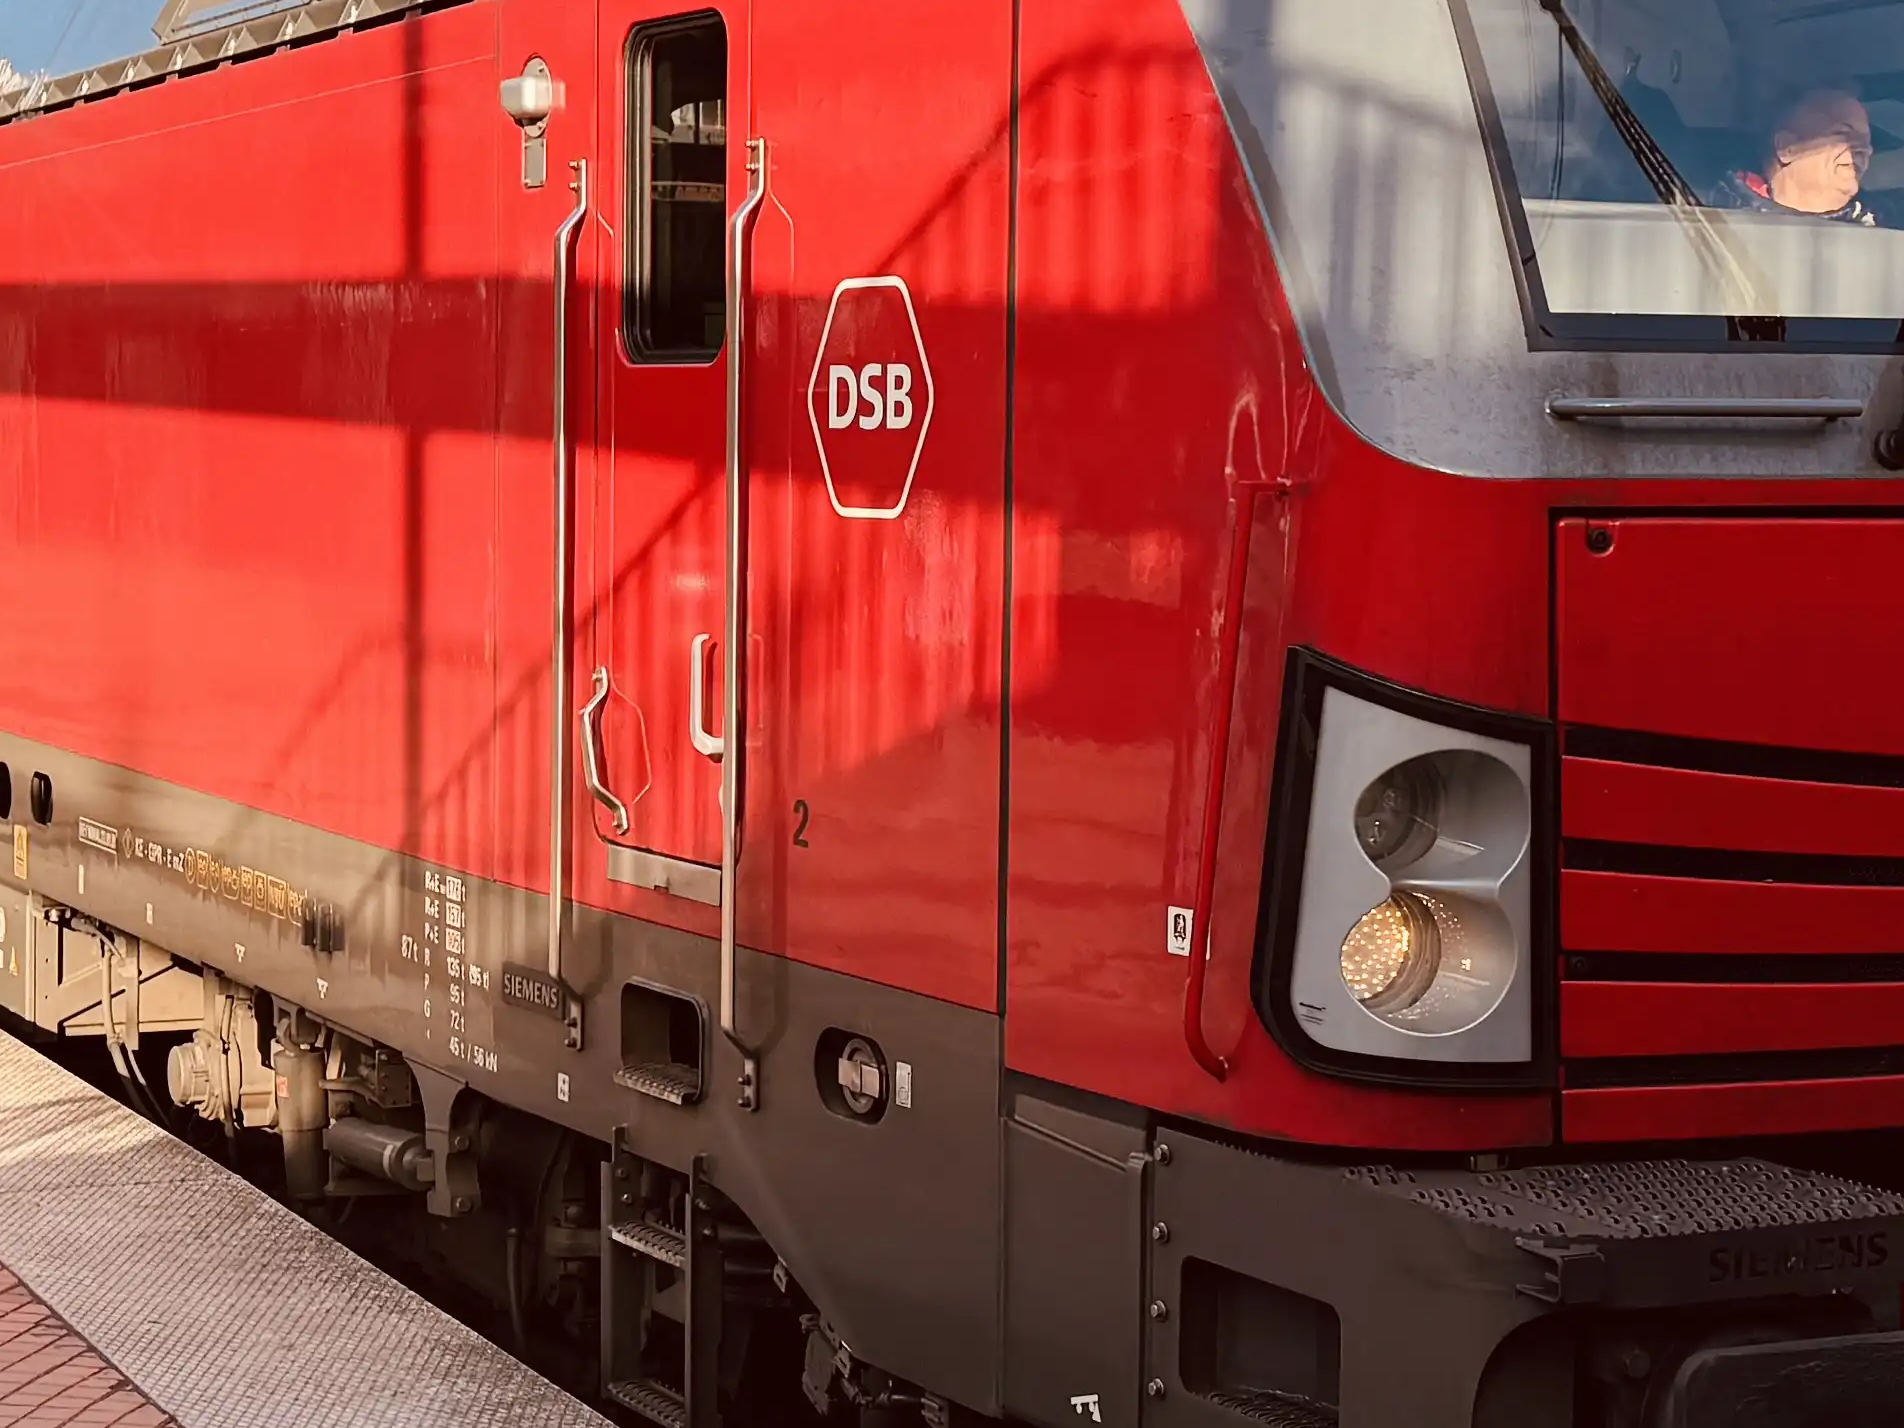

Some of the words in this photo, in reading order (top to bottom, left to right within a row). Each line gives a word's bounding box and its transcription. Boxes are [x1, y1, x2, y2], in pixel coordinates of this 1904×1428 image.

[829, 363, 913, 430] DSB
[793, 800, 809, 848] 2
[401, 934, 413, 960] 87
[504, 974, 558, 1009] SIEMENS
[424, 1000, 431, 1018] G
[450, 1010, 460, 1031] 72
[1708, 1231, 1889, 1283] SIEMENS
